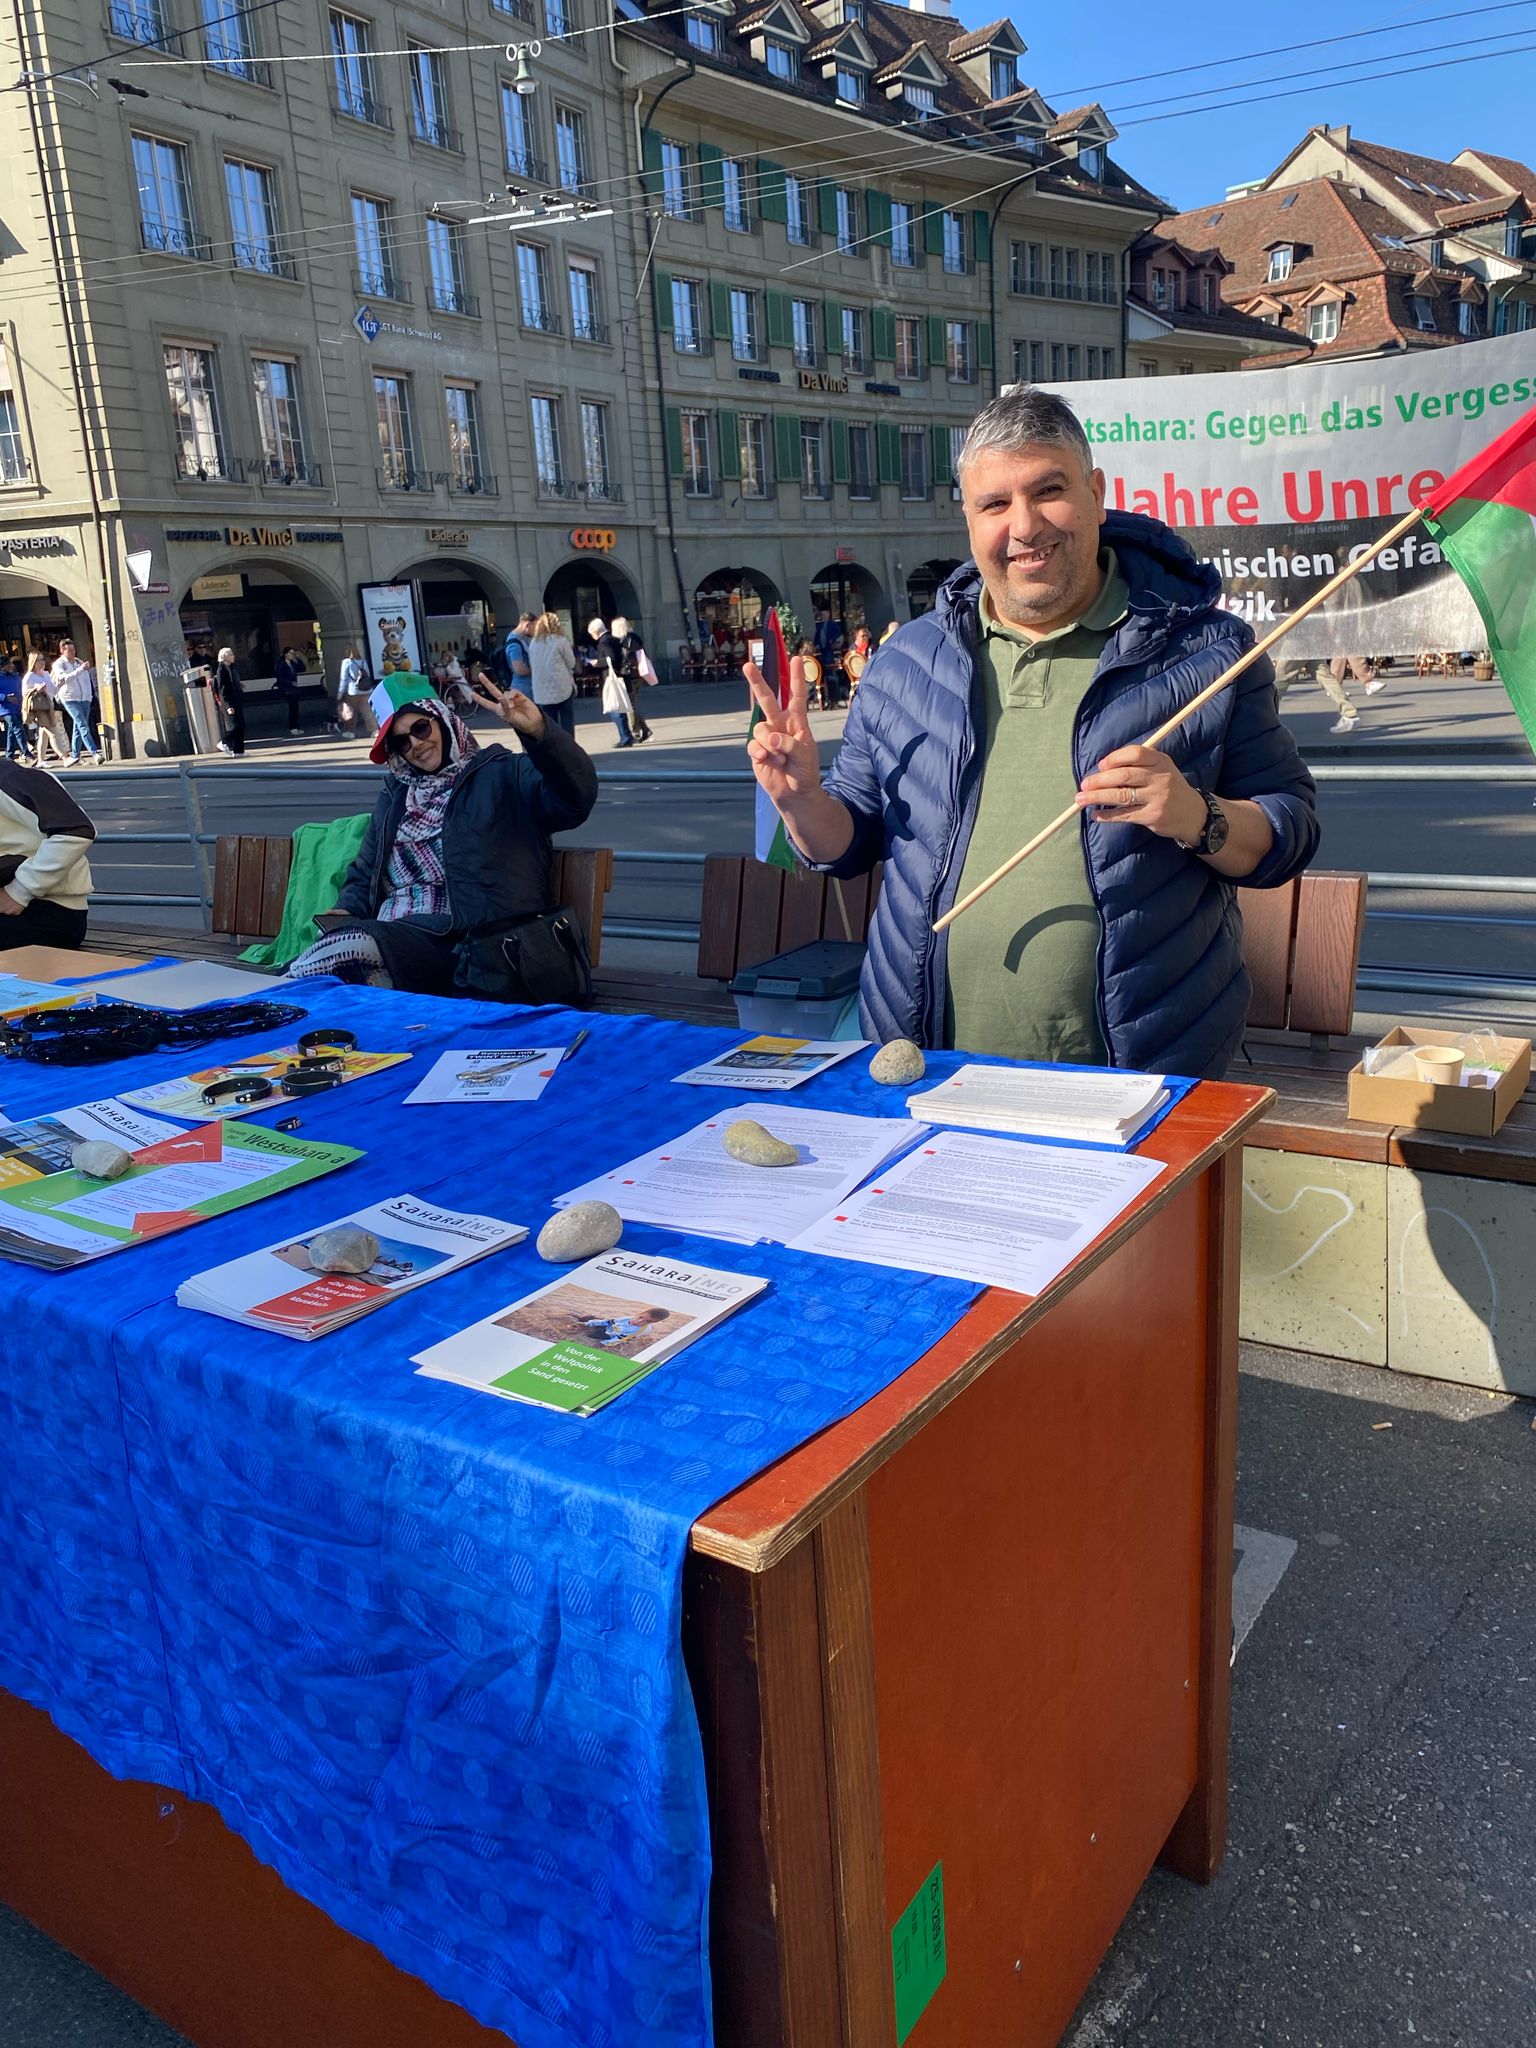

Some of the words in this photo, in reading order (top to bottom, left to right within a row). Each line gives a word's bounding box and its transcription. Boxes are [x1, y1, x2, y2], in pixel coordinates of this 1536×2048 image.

[362, 321, 378, 333] LGT
[433, 332, 442, 341] AG
[1205, 410, 1308, 446] Gegen
[1320, 400, 1384, 433] das
[0, 535, 60, 550] PASTERIA
[226, 527, 251, 546] Da
[570, 528, 617, 553] coop
[243, 1132, 333, 1161] Westsahara
[552, 1352, 605, 1375] Weltpolitik
[564, 1346, 583, 1357] Von
[583, 1350, 602, 1362] der
[539, 1360, 550, 1368] in
[550, 1363, 571, 1375] den
[527, 1366, 552, 1380] Sand
[550, 1375, 590, 1392] gesetzt
